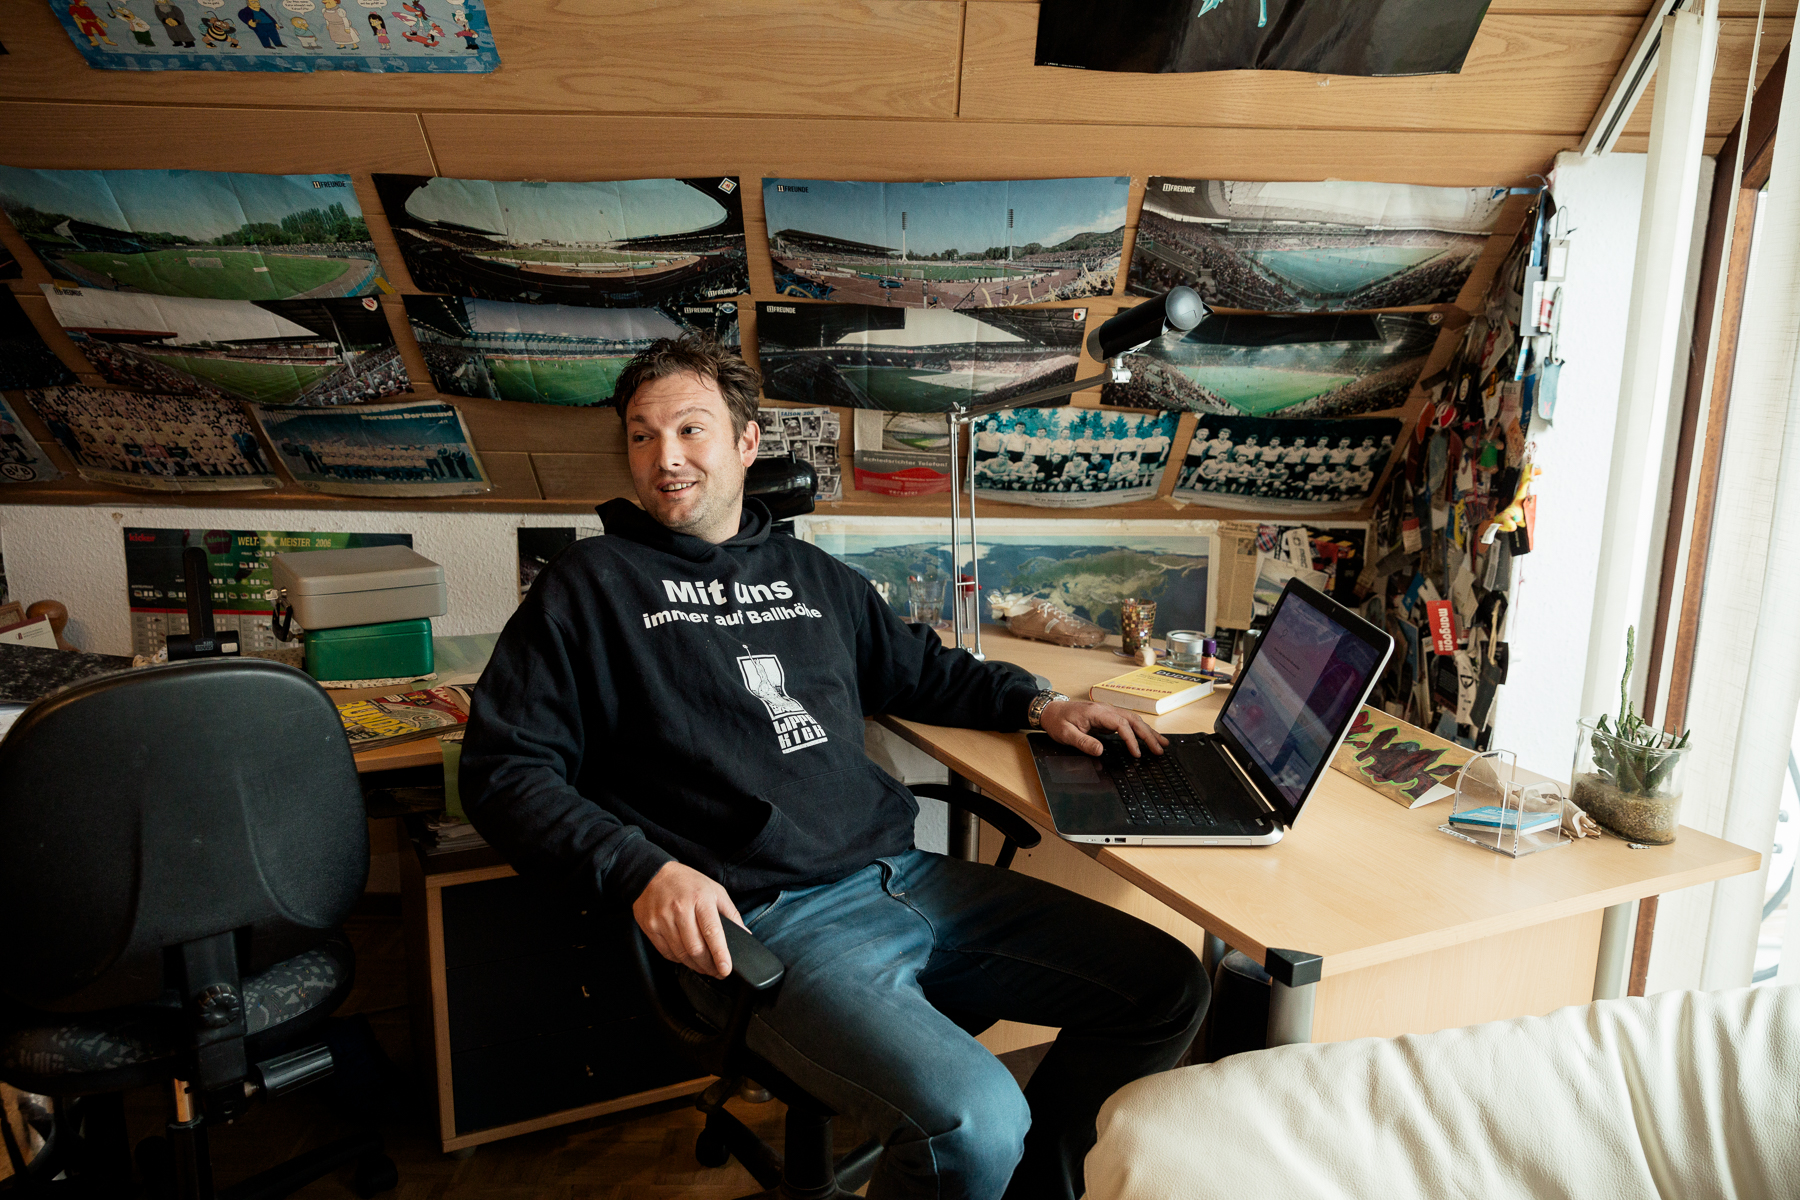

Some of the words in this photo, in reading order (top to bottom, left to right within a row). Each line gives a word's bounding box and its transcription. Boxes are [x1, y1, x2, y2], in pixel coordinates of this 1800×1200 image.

[776, 185, 809, 193] 11FREUNDE
[1162, 183, 1196, 193] 11FREUNDE
[766, 305, 796, 314] 11FREUNDE
[863, 456, 916, 466] Schiedsrichter
[4, 465, 31, 476] BVB
[129, 533, 155, 542] kicker
[237, 536, 260, 546] WELT-
[280, 537, 311, 547] MEISTER
[315, 538, 332, 548] 2006
[662, 579, 727, 606] Mit
[734, 580, 793, 604] uns
[643, 609, 709, 629] immer
[714, 610, 744, 627] auf
[745, 603, 823, 624] Ballhöhe
[1438, 608, 1454, 651] mangoon
[1156, 669, 1201, 682] DUDEN
[777, 724, 827, 749] KICK
